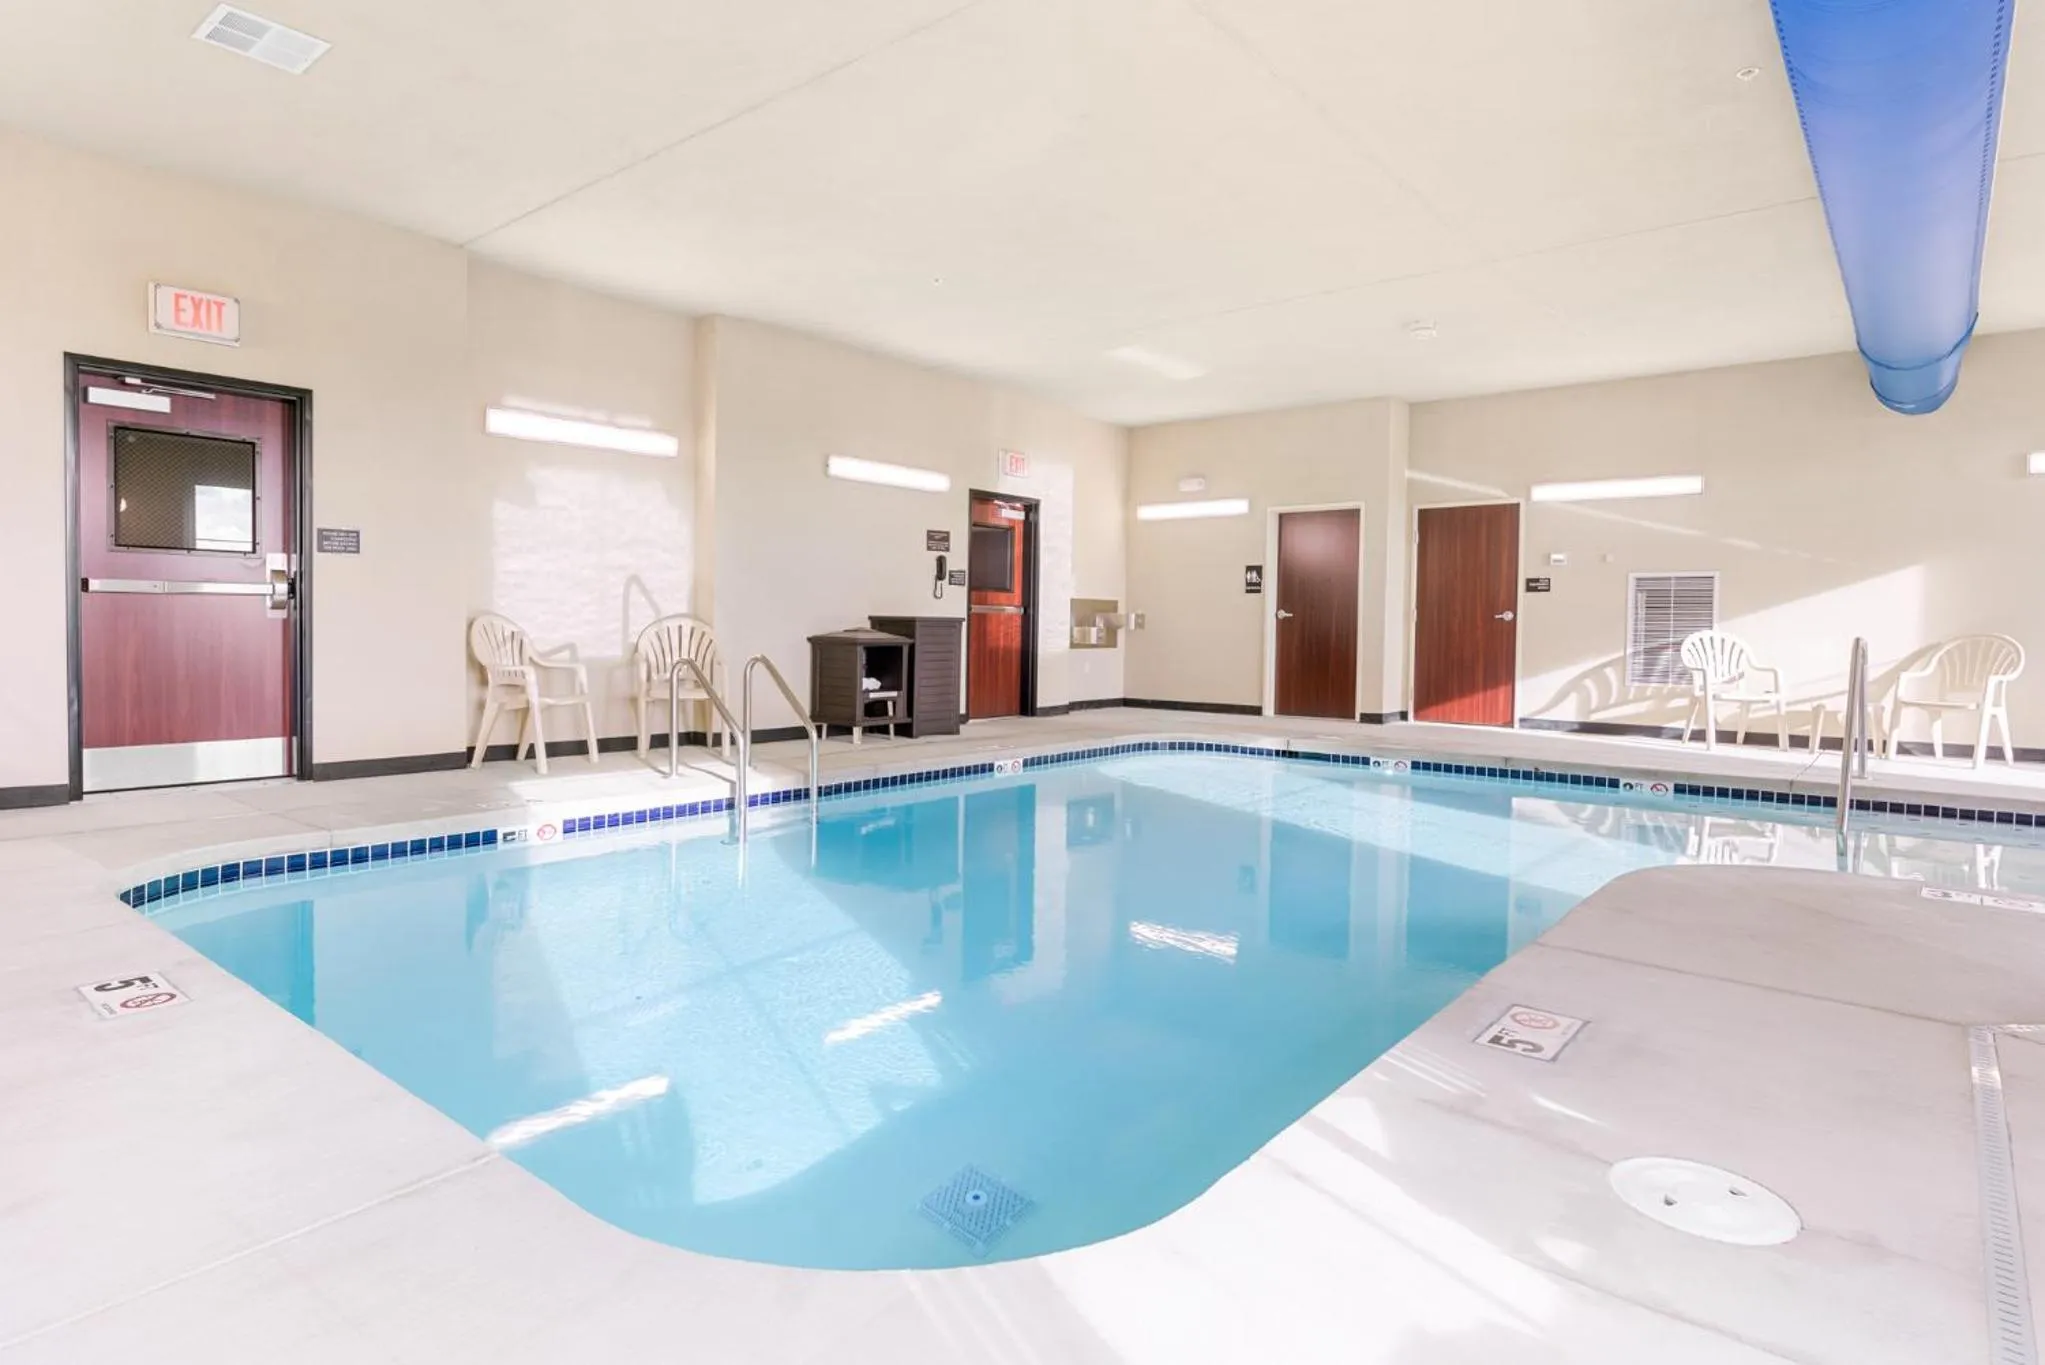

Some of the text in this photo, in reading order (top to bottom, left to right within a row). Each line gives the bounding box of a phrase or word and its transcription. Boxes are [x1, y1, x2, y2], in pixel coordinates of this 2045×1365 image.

[173, 292, 226, 332] EXIT
[94, 976, 152, 992] 5
[1487, 1034, 1545, 1054] 5
